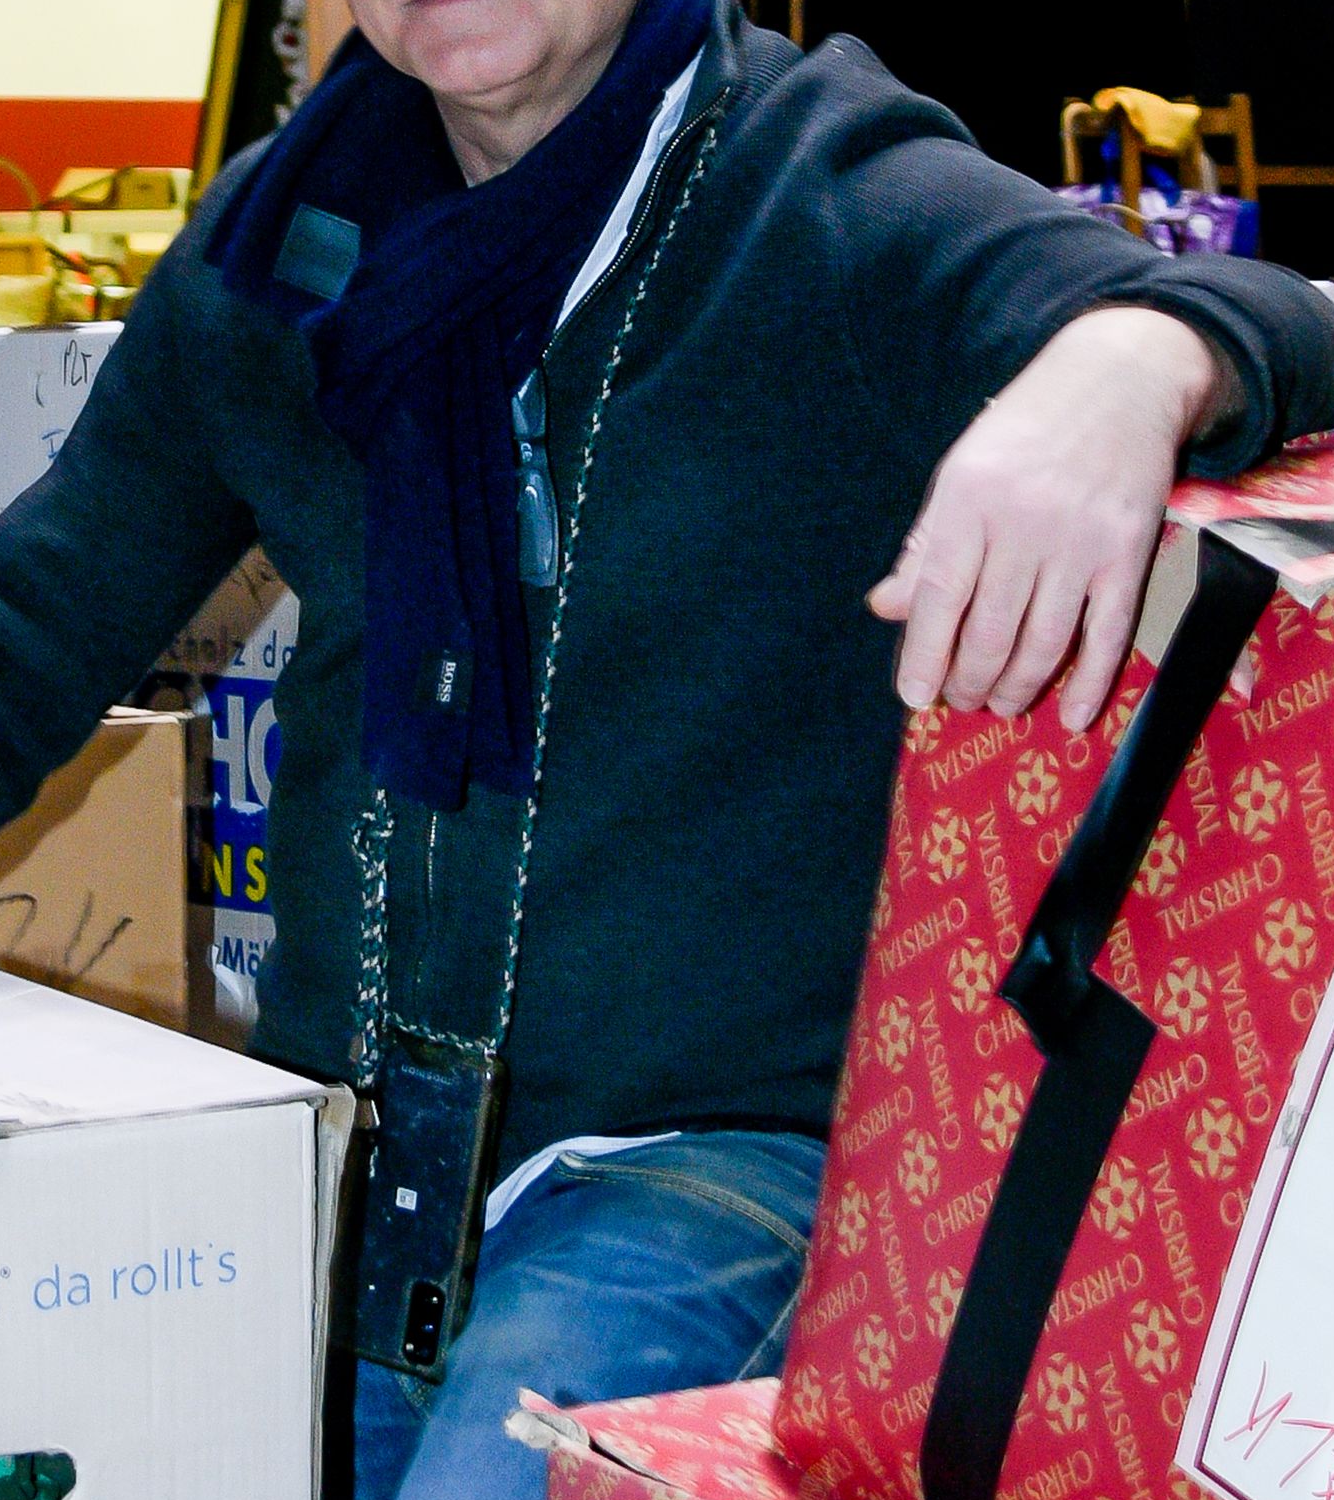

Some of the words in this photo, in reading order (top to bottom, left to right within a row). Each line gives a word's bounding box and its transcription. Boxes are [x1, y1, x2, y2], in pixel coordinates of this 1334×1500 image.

[440, 661, 457, 703] BOSS
[1156, 853, 1284, 939] CHRISTAL
[1217, 950, 1271, 1124] CHRISTAL
[34, 1264, 91, 1311] da
[873, 1177, 917, 1342] CHRISTAL
[1147, 1151, 1204, 1326] CHRISTAL
